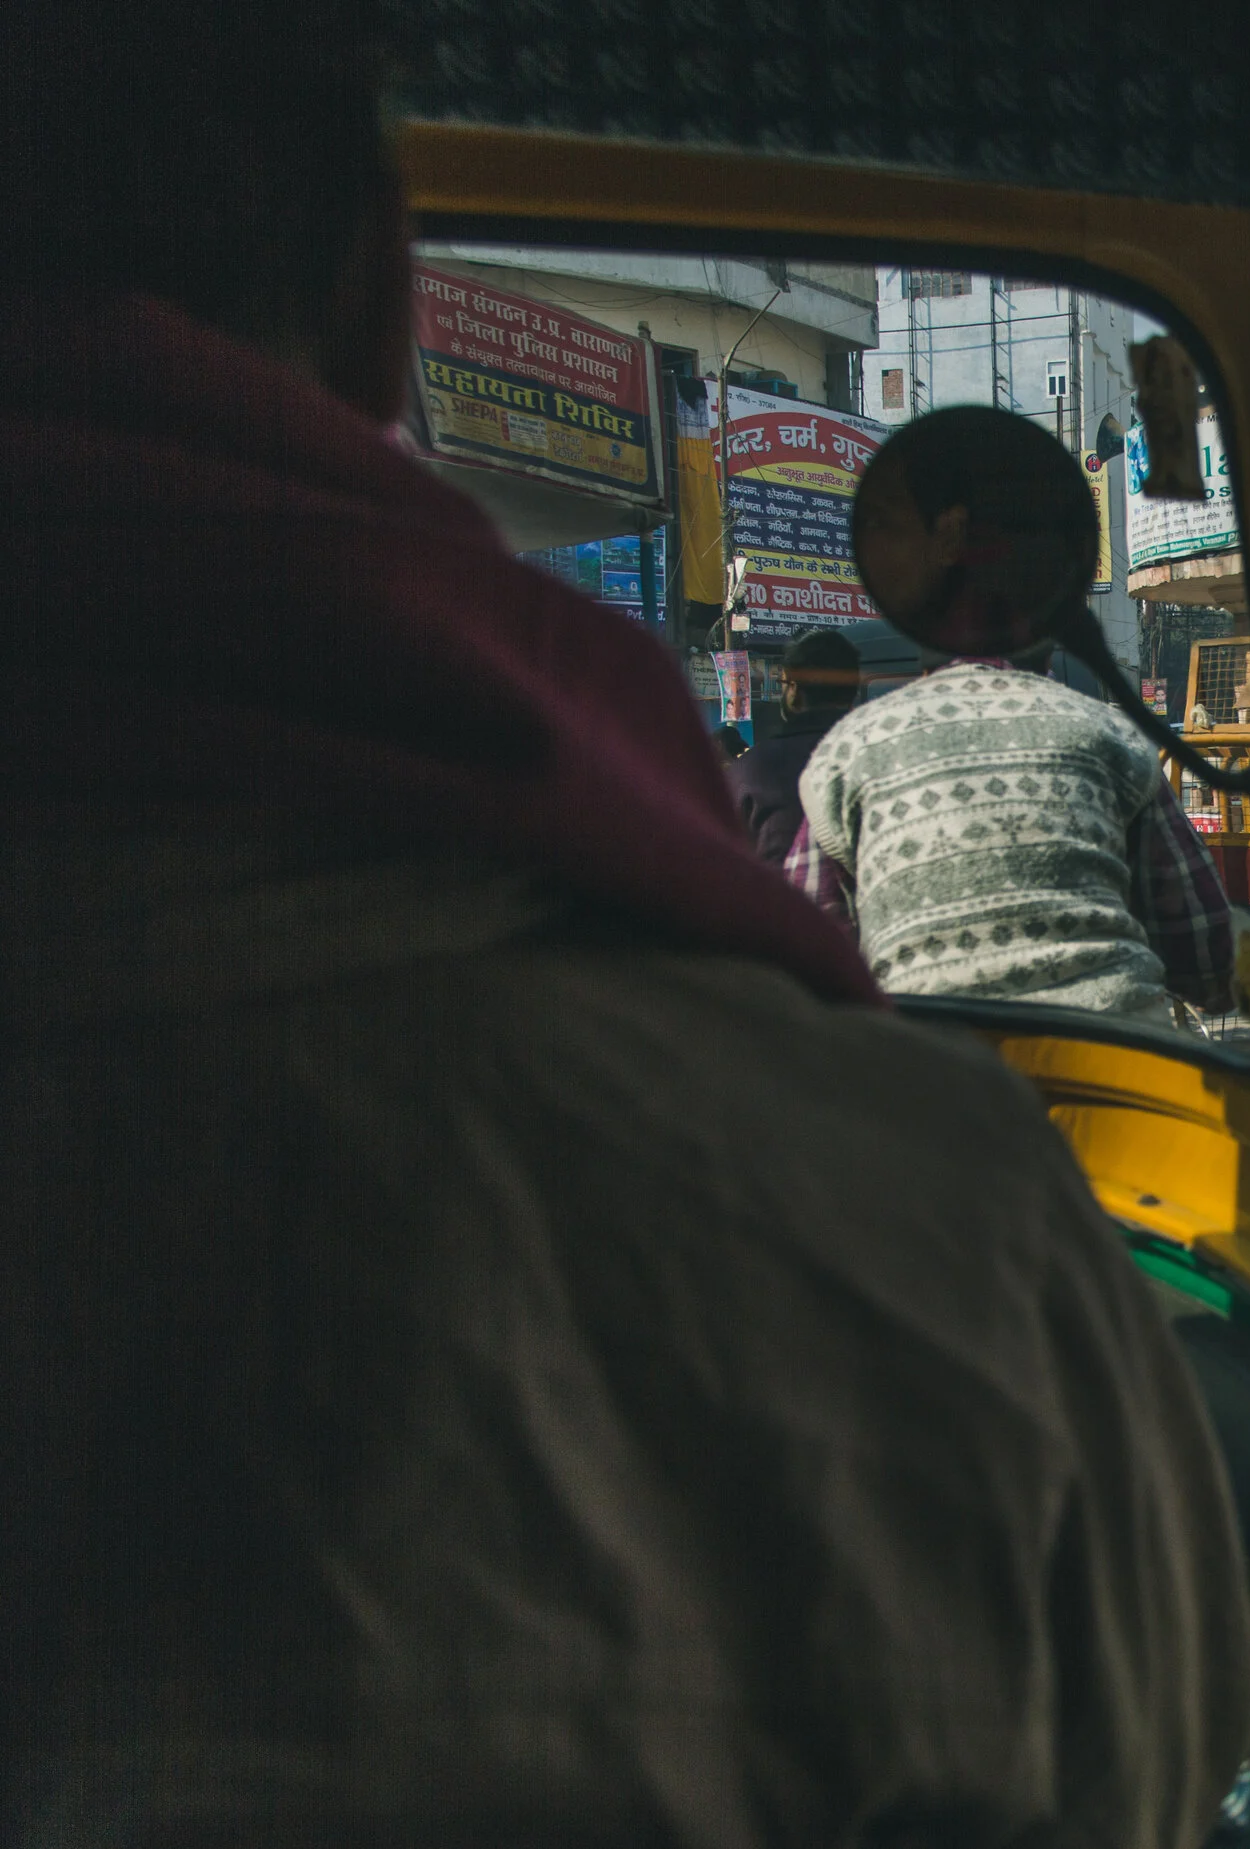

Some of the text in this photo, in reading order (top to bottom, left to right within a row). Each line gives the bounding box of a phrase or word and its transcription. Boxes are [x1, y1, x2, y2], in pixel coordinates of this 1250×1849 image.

[471, 291, 528, 327] संगठन
[570, 327, 633, 365] वाराणसी
[456, 310, 506, 346] जिला
[509, 331, 559, 363] पुलिस
[562, 349, 618, 384] प्रशासन
[451, 337, 464, 355] के
[466, 343, 504, 367] संयुक्त
[558, 374, 572, 390] पर
[574, 381, 618, 405] आयोजित
[423, 358, 547, 412] सहायता
[553, 391, 635, 440] शिविर
[451, 397, 499, 425] SHEPA
[777, 419, 826, 454] चर्म,
[776, 466, 805, 484] अनुभूत
[806, 560, 818, 574] के
[771, 580, 853, 613] काशीदत्त
[626, 609, 645, 621] Pvt.
